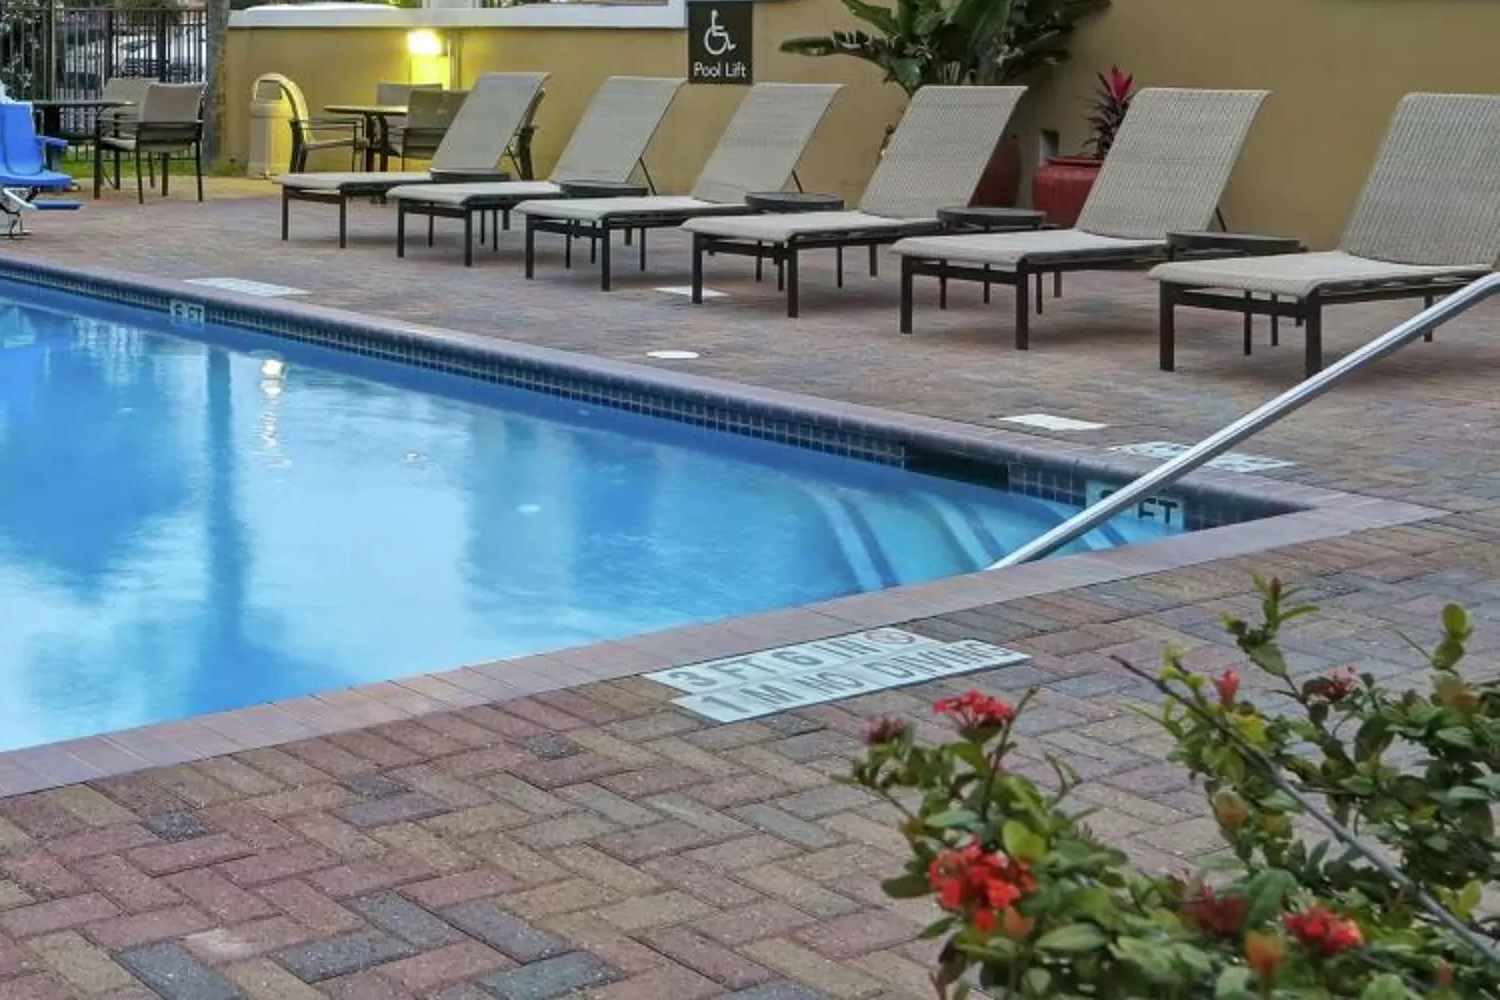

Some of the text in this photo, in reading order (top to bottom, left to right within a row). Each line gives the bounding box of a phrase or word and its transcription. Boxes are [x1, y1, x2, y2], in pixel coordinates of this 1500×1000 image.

[693, 61, 747, 78] Pool Lift
[667, 639, 882, 687] 3 FT 6 IN
[702, 695, 752, 713] 1
[790, 671, 865, 695] NO
[862, 643, 1012, 679] DIVING
